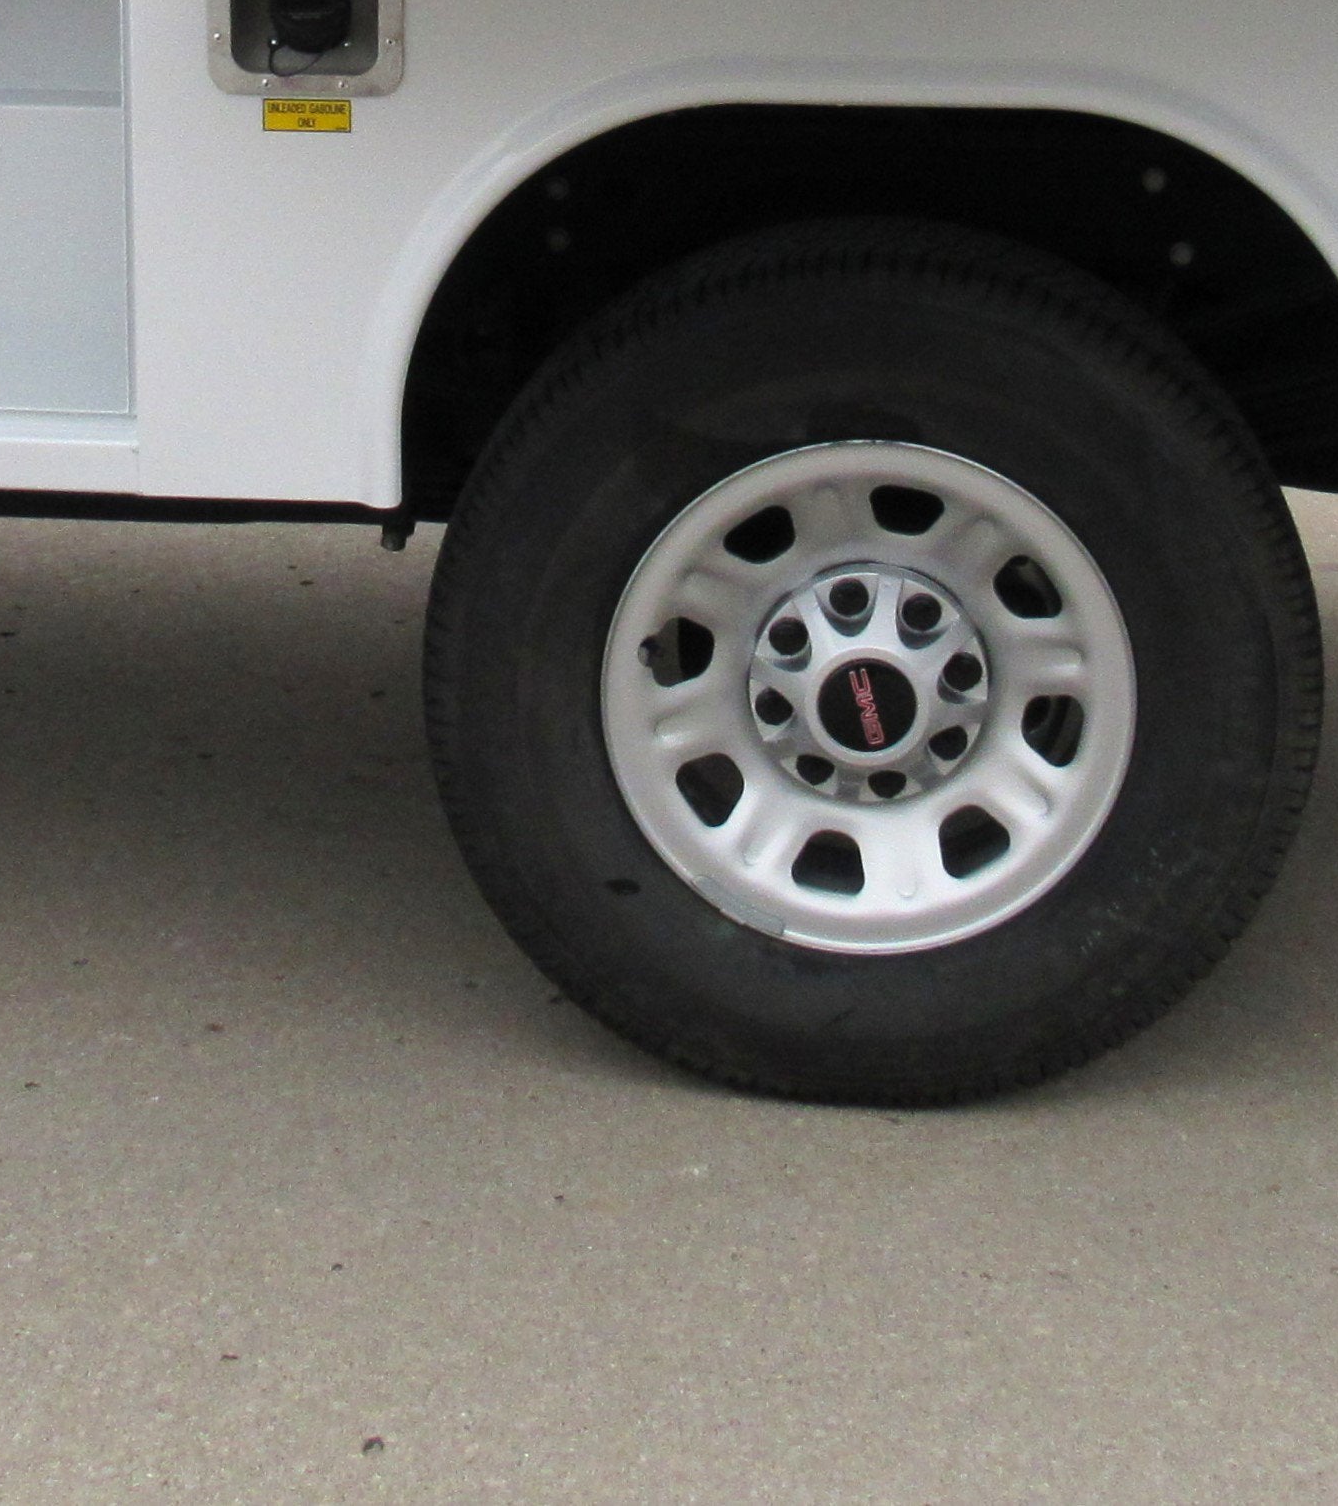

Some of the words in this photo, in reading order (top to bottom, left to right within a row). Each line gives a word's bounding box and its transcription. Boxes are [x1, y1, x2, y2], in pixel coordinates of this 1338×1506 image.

[267, 102, 306, 114] UNLEADED
[309, 103, 347, 115] GASOLINE
[298, 117, 316, 128] ONLY
[849, 667, 885, 745] GMC
